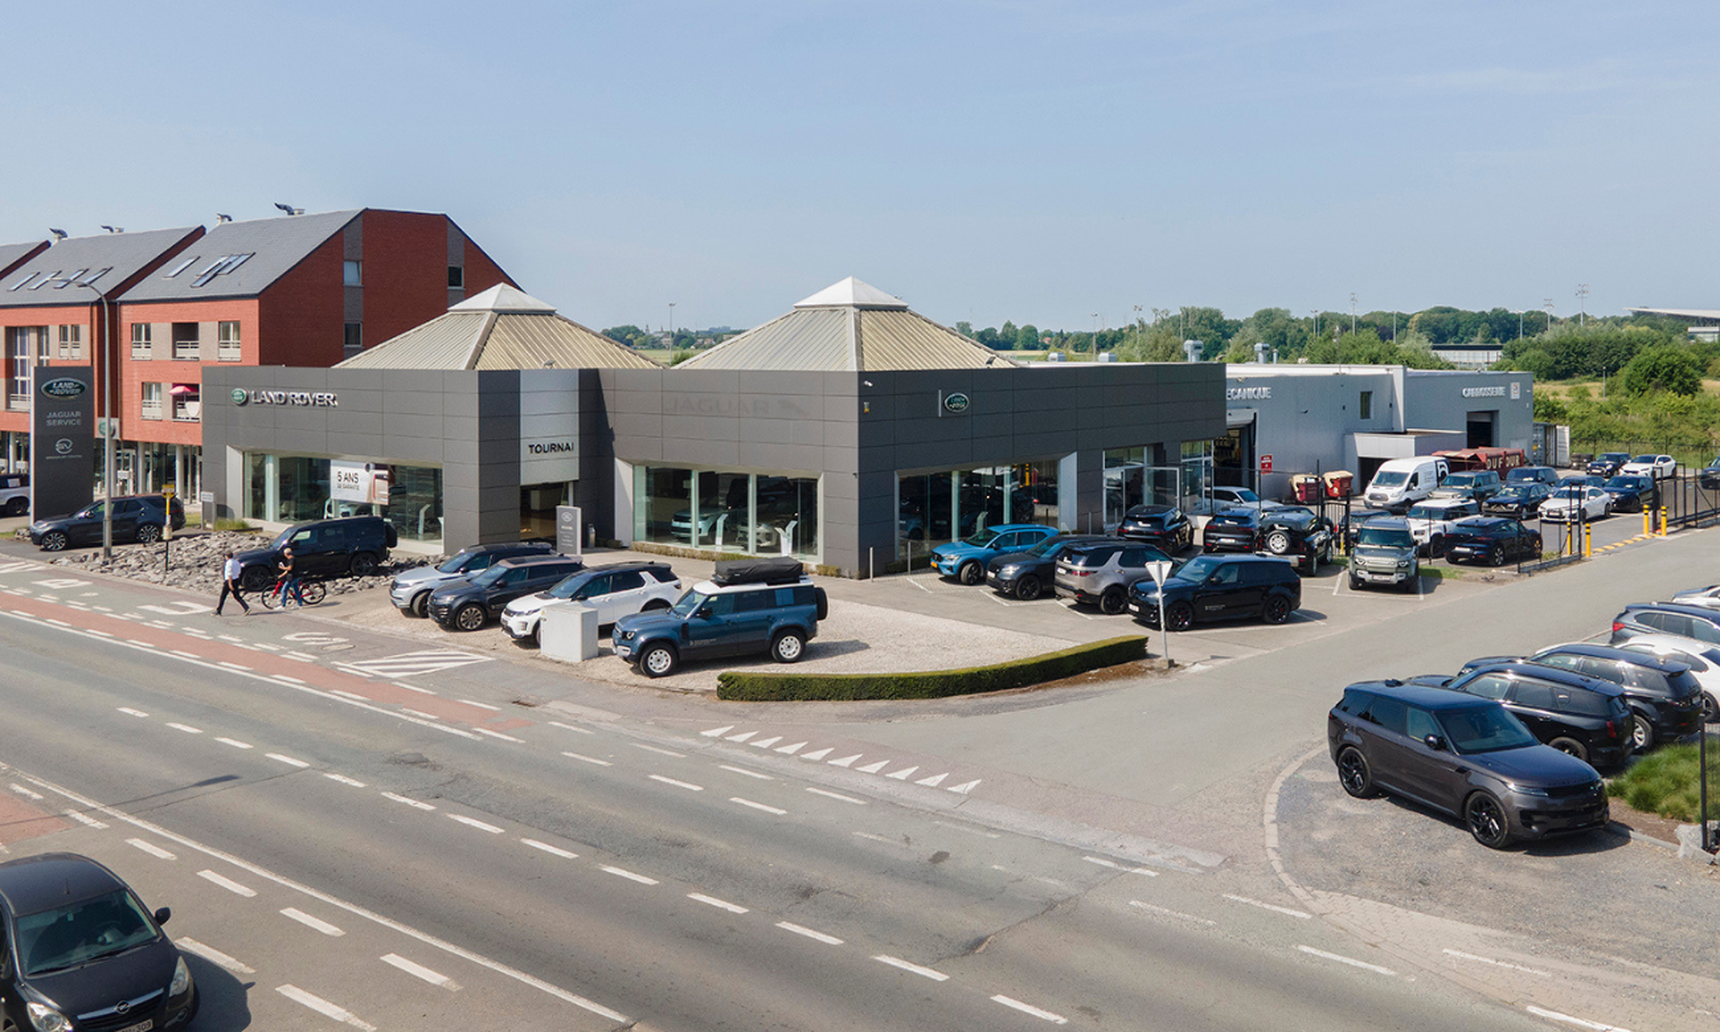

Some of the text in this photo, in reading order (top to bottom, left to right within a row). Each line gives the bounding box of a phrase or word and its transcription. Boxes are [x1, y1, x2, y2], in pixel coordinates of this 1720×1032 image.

[251, 390, 287, 405] LAND
[289, 391, 338, 407] ROVER
[1226, 386, 1271, 400] ECANIQUE
[528, 441, 574, 454] TOURNAI
[337, 470, 360, 484] 5 ANS
